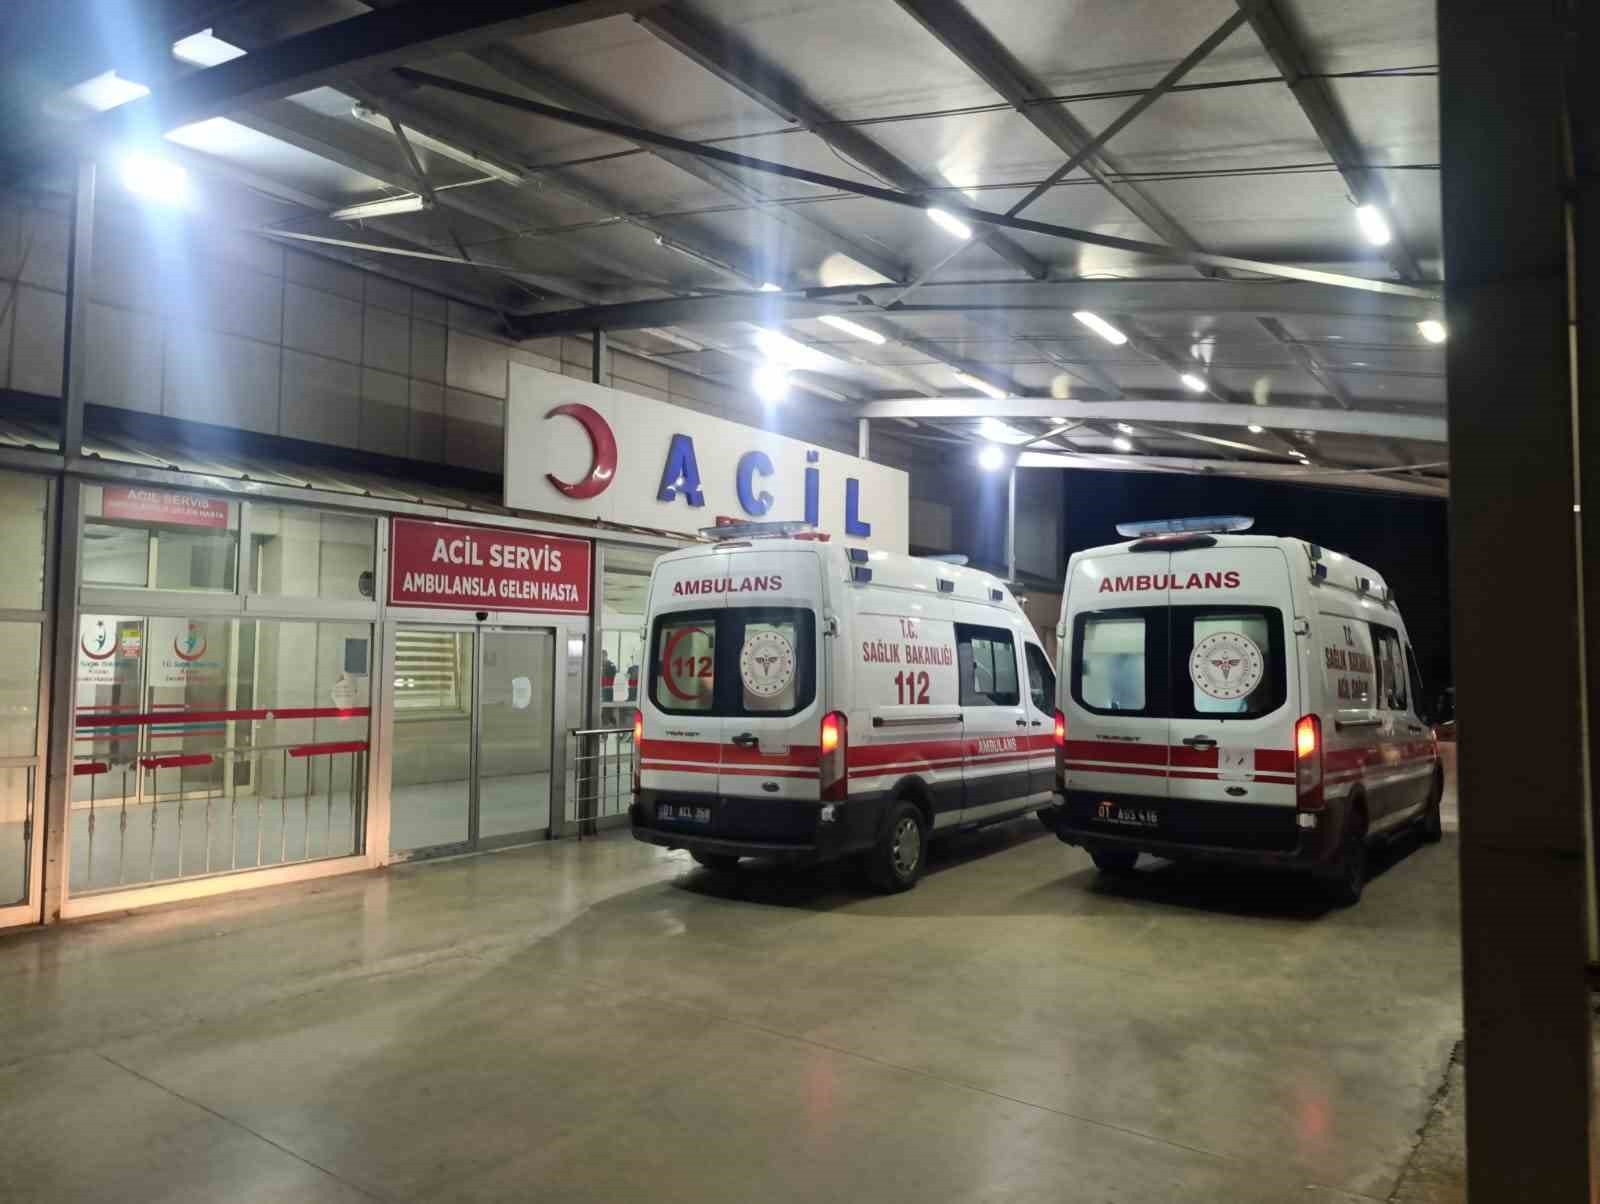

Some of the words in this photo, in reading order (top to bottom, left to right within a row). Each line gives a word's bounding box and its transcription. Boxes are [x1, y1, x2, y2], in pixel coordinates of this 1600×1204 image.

[657, 433, 871, 537] ACİL
[431, 536, 483, 566] ACİL
[489, 544, 562, 572] SERVİS
[402, 572, 497, 598] AMBULANSLA
[499, 579, 539, 600] GELEN
[541, 582, 579, 602] HASTA
[672, 575, 783, 596] AMBULANS
[1099, 571, 1241, 593] AMBULANS
[900, 618, 918, 640] T.C.
[863, 640, 900, 664] SAĞLIK
[906, 645, 953, 666] BAKANLIĞI
[673, 656, 713, 678] 112
[894, 670, 930, 705] 112
